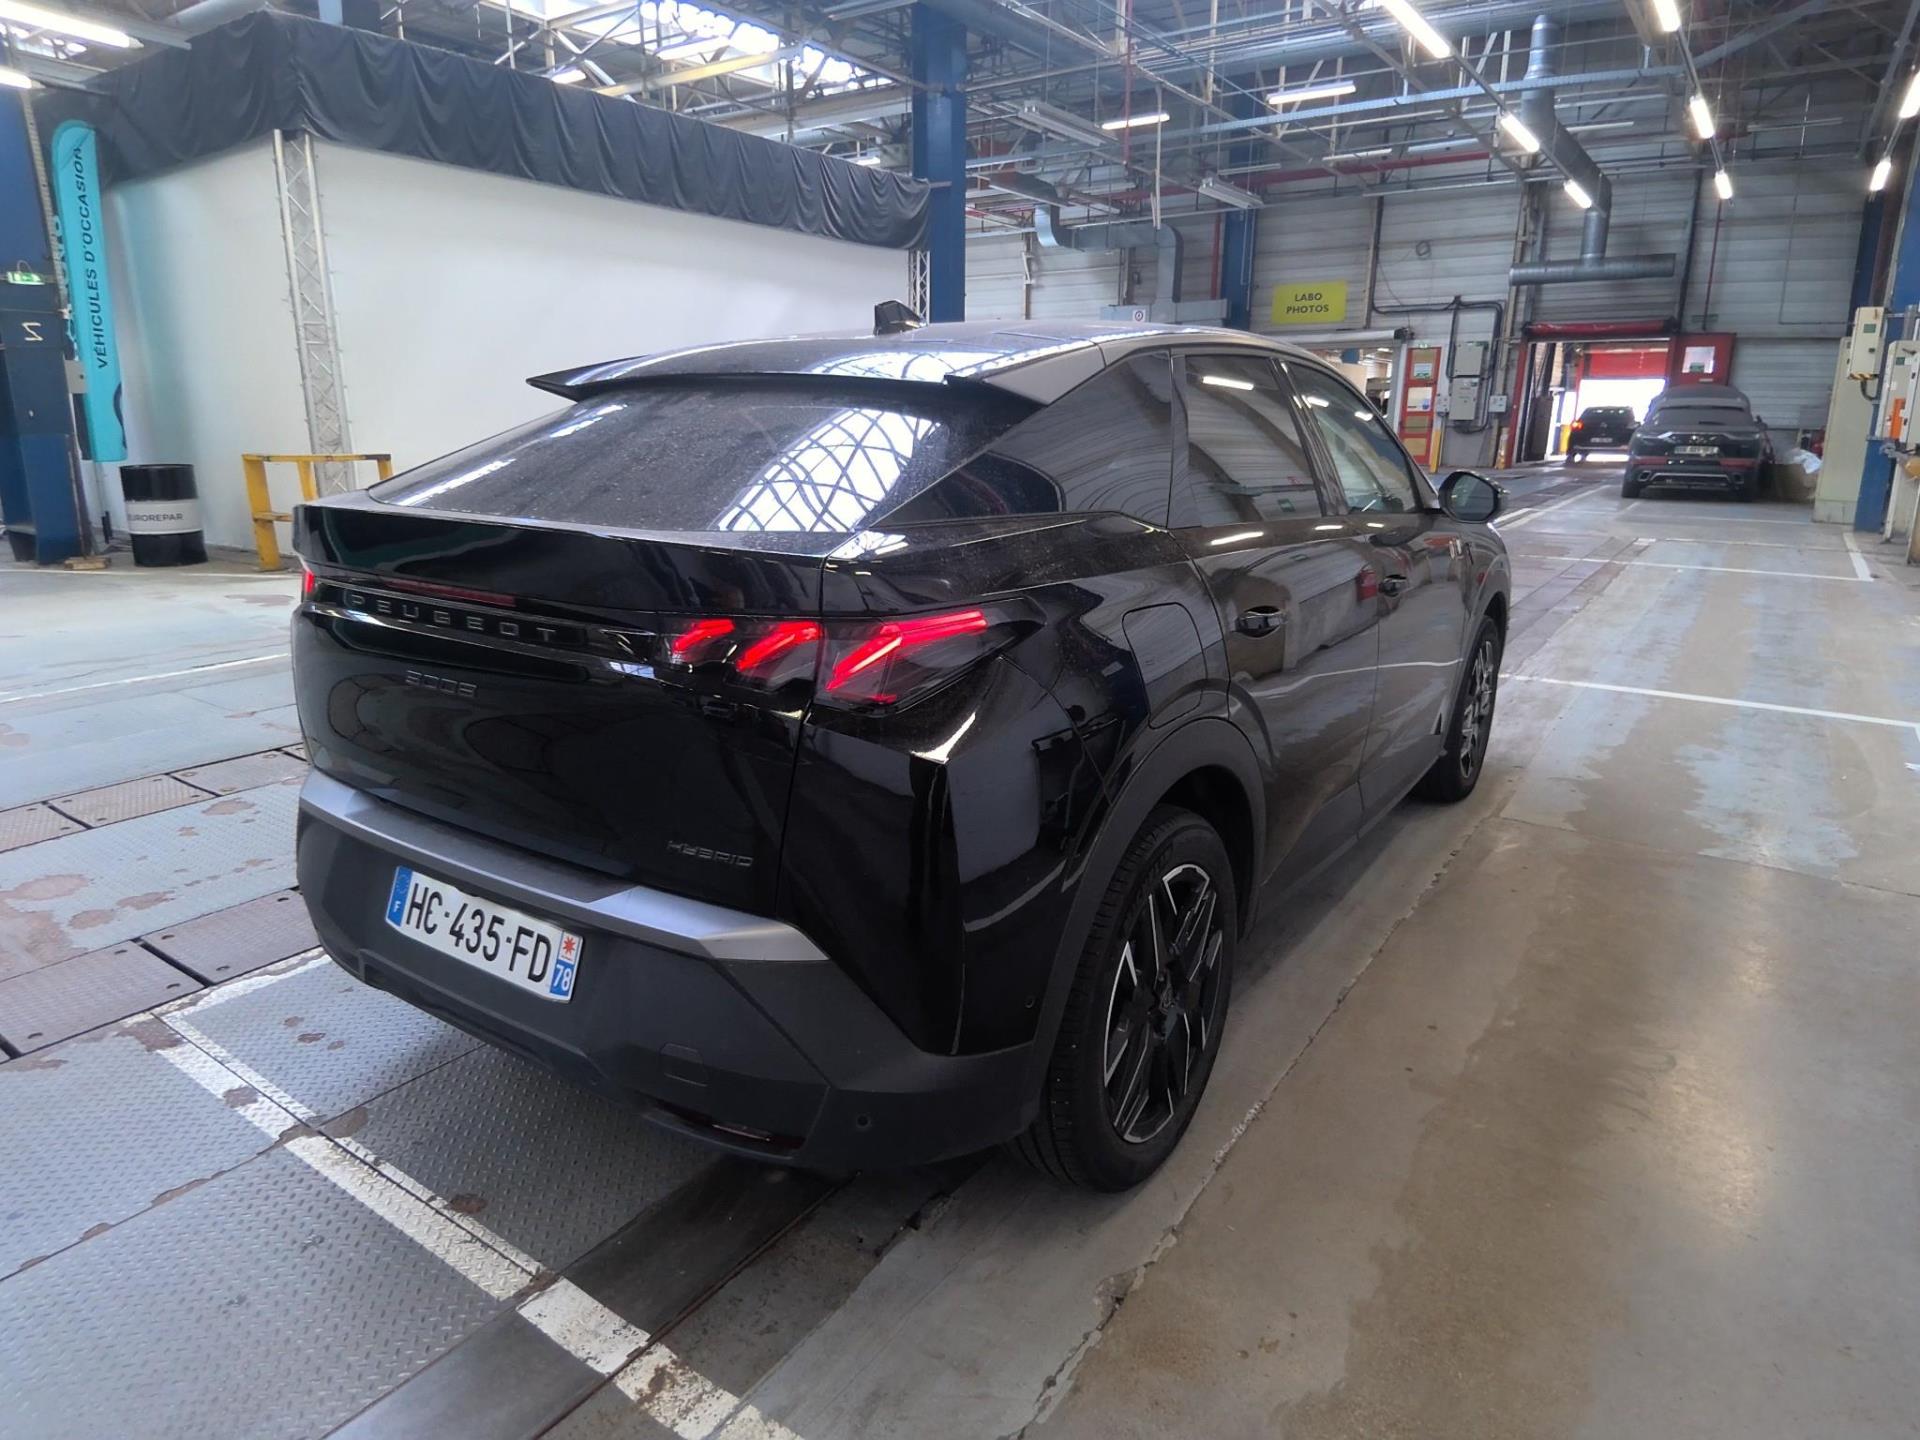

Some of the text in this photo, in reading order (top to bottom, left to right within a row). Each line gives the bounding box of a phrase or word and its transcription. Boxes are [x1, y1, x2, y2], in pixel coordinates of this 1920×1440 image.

[73, 147, 109, 369] VÉHICULES D'OCCASION
[1285, 304, 1329, 315] PHOTOS
[1294, 292, 1323, 302] LABO
[350, 593, 557, 642] PEUGEOT
[664, 840, 754, 867] HYBRID
[393, 901, 400, 912] F
[553, 963, 573, 992] 78
